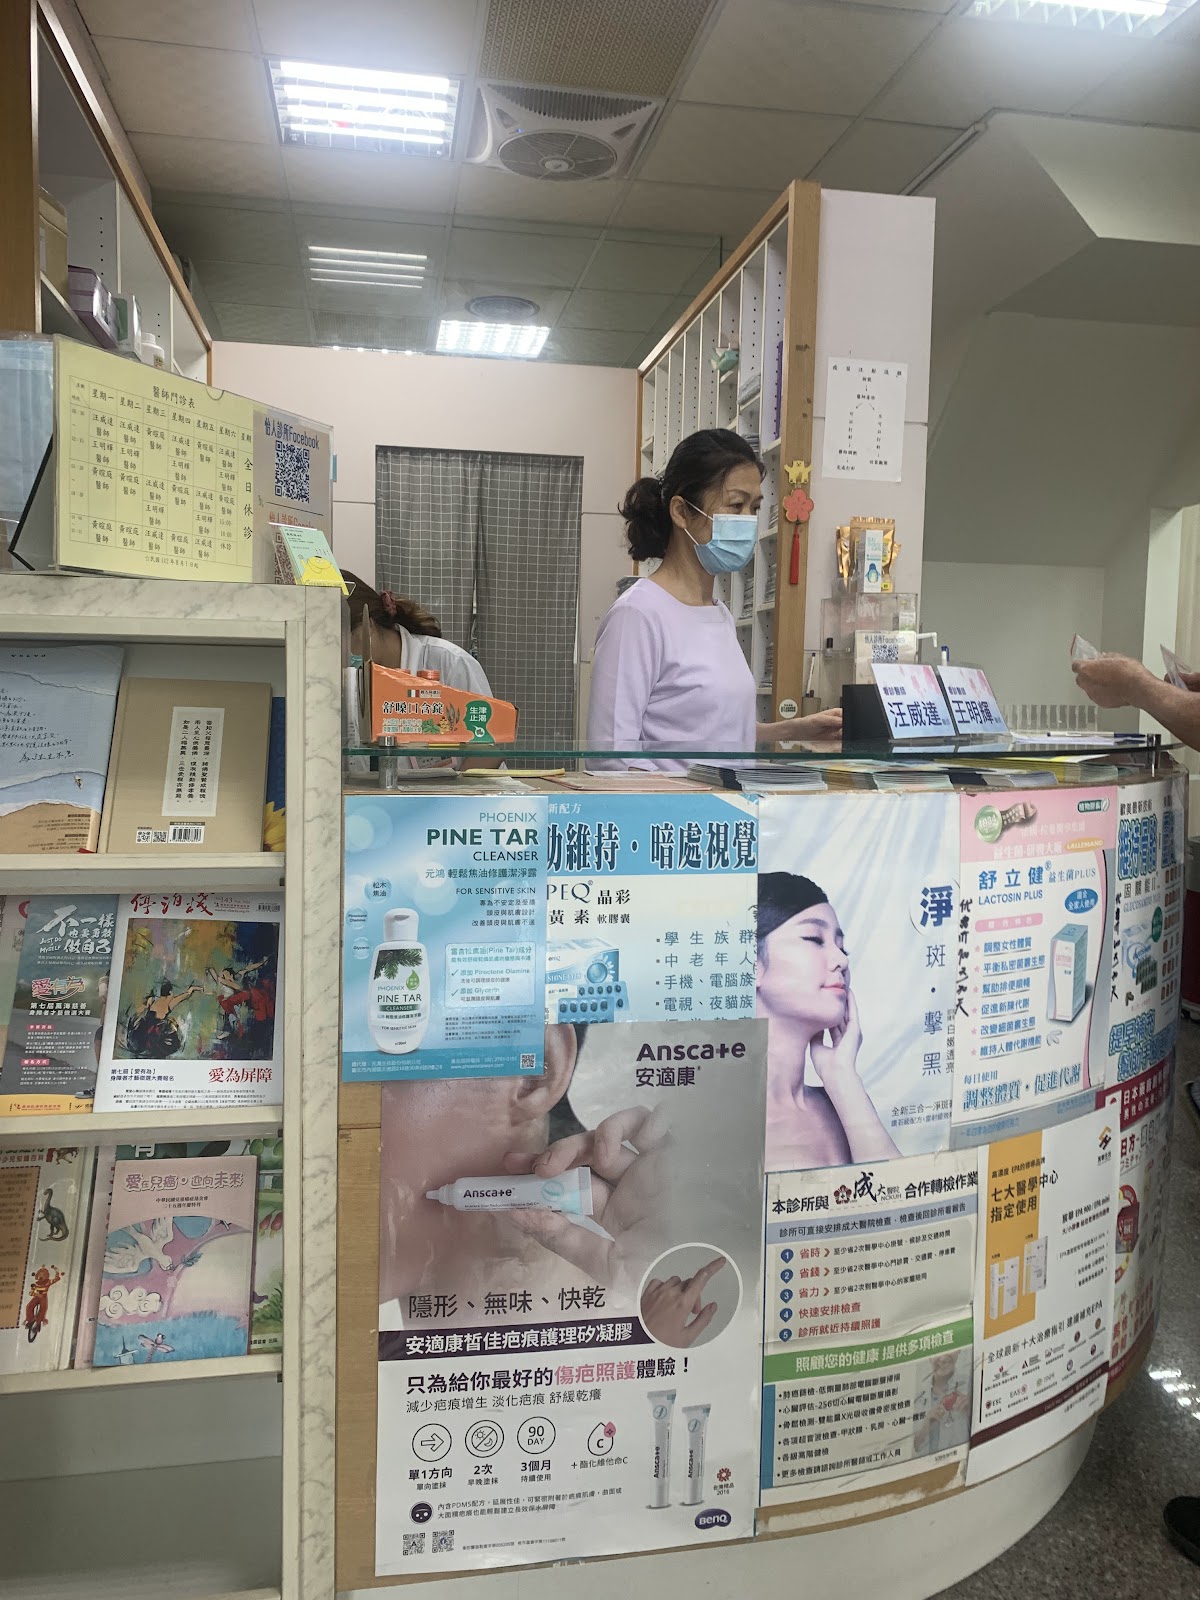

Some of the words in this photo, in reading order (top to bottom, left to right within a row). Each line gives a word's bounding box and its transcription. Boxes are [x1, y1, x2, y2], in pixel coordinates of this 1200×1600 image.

[153, 385, 195, 409] 醫師門診表
[92, 388, 114, 401] 星期一
[120, 397, 141, 409] 星期二
[146, 405, 166, 417] 星期三
[172, 412, 191, 424] 星期四
[196, 420, 215, 432] 星期五
[219, 426, 236, 438] 星期六
[264, 417, 319, 450] 怡人診所Facebook
[469, 706, 487, 714] 生津
[469, 714, 487, 722] 止渴
[887, 701, 942, 728] 汪威達
[952, 700, 994, 724] 王明輝
[479, 812, 537, 823] PHOENIX
[548, 803, 582, 815] 新配方
[427, 828, 482, 846] PINE
[490, 828, 539, 846] TAR
[1067, 840, 1103, 850] LALLEMAND
[473, 851, 539, 861] CLEANSER
[978, 866, 1044, 891] 舒立健
[1048, 868, 1096, 884] 益生菌PLUS
[475, 887, 515, 895] SENSITIVE
[597, 889, 631, 905] 晶彩
[978, 892, 1021, 905] LACTOSIN
[1023, 889, 1043, 899] PLUS
[35, 904, 114, 937] 不一樣
[548, 910, 590, 926] 黃素
[597, 913, 631, 925] 軟膠囊
[39, 937, 54, 945] JUST
[63, 938, 112, 955] 做自己
[664, 929, 754, 947] 學生族群
[39, 944, 62, 954] MYSELF
[664, 951, 753, 968] 中老年人
[664, 972, 754, 990] 手機、電腦族
[982, 977, 1031, 995] 幫助排便順暢
[377, 994, 400, 1003] PINE
[402, 993, 422, 1002] TAR
[663, 994, 753, 1012] 電視、夜貓族
[981, 997, 1030, 1016] 促進新陳代謝
[208, 1067, 273, 1084] 愛為屏障
[635, 1066, 696, 1088] 安適康
[964, 1070, 998, 1085] 每日使用
[771, 1195, 830, 1215] 本診所與
[904, 1171, 978, 1200] 合作轉檢作業
[990, 1169, 1059, 1203] 七大醫學中心
[990, 1195, 1038, 1224] 指定使用
[784, 1252, 790, 1260] 1
[799, 1247, 820, 1259] 省時
[784, 1272, 790, 1280] 2
[799, 1267, 821, 1279] 省錢
[407, 1285, 606, 1319] 隱形、無味、快乾
[784, 1292, 790, 1300] 3
[798, 1287, 820, 1299] 省力
[783, 1311, 790, 1319] 4
[798, 1302, 861, 1319] 快速安排檢查
[783, 1331, 789, 1339] 5
[798, 1318, 881, 1338] 診所就近持續照護
[795, 1349, 880, 1373] 照顧您的健康
[882, 1331, 954, 1361] 提供多項檢查
[406, 1356, 690, 1395] 只為給你最好的傷疤照護體驗！
[406, 1394, 488, 1413] 減少疤痕增生
[492, 1392, 546, 1409] 淡化疤痕
[528, 1425, 545, 1438] 90
[527, 1437, 545, 1446] DAY
[596, 1438, 604, 1449] C
[408, 1466, 453, 1481] 單1方向
[473, 1463, 493, 1475] 2次
[520, 1459, 551, 1472] 3個月
[520, 1473, 552, 1483] 持續使用
[699, 1514, 728, 1525] BenQ
